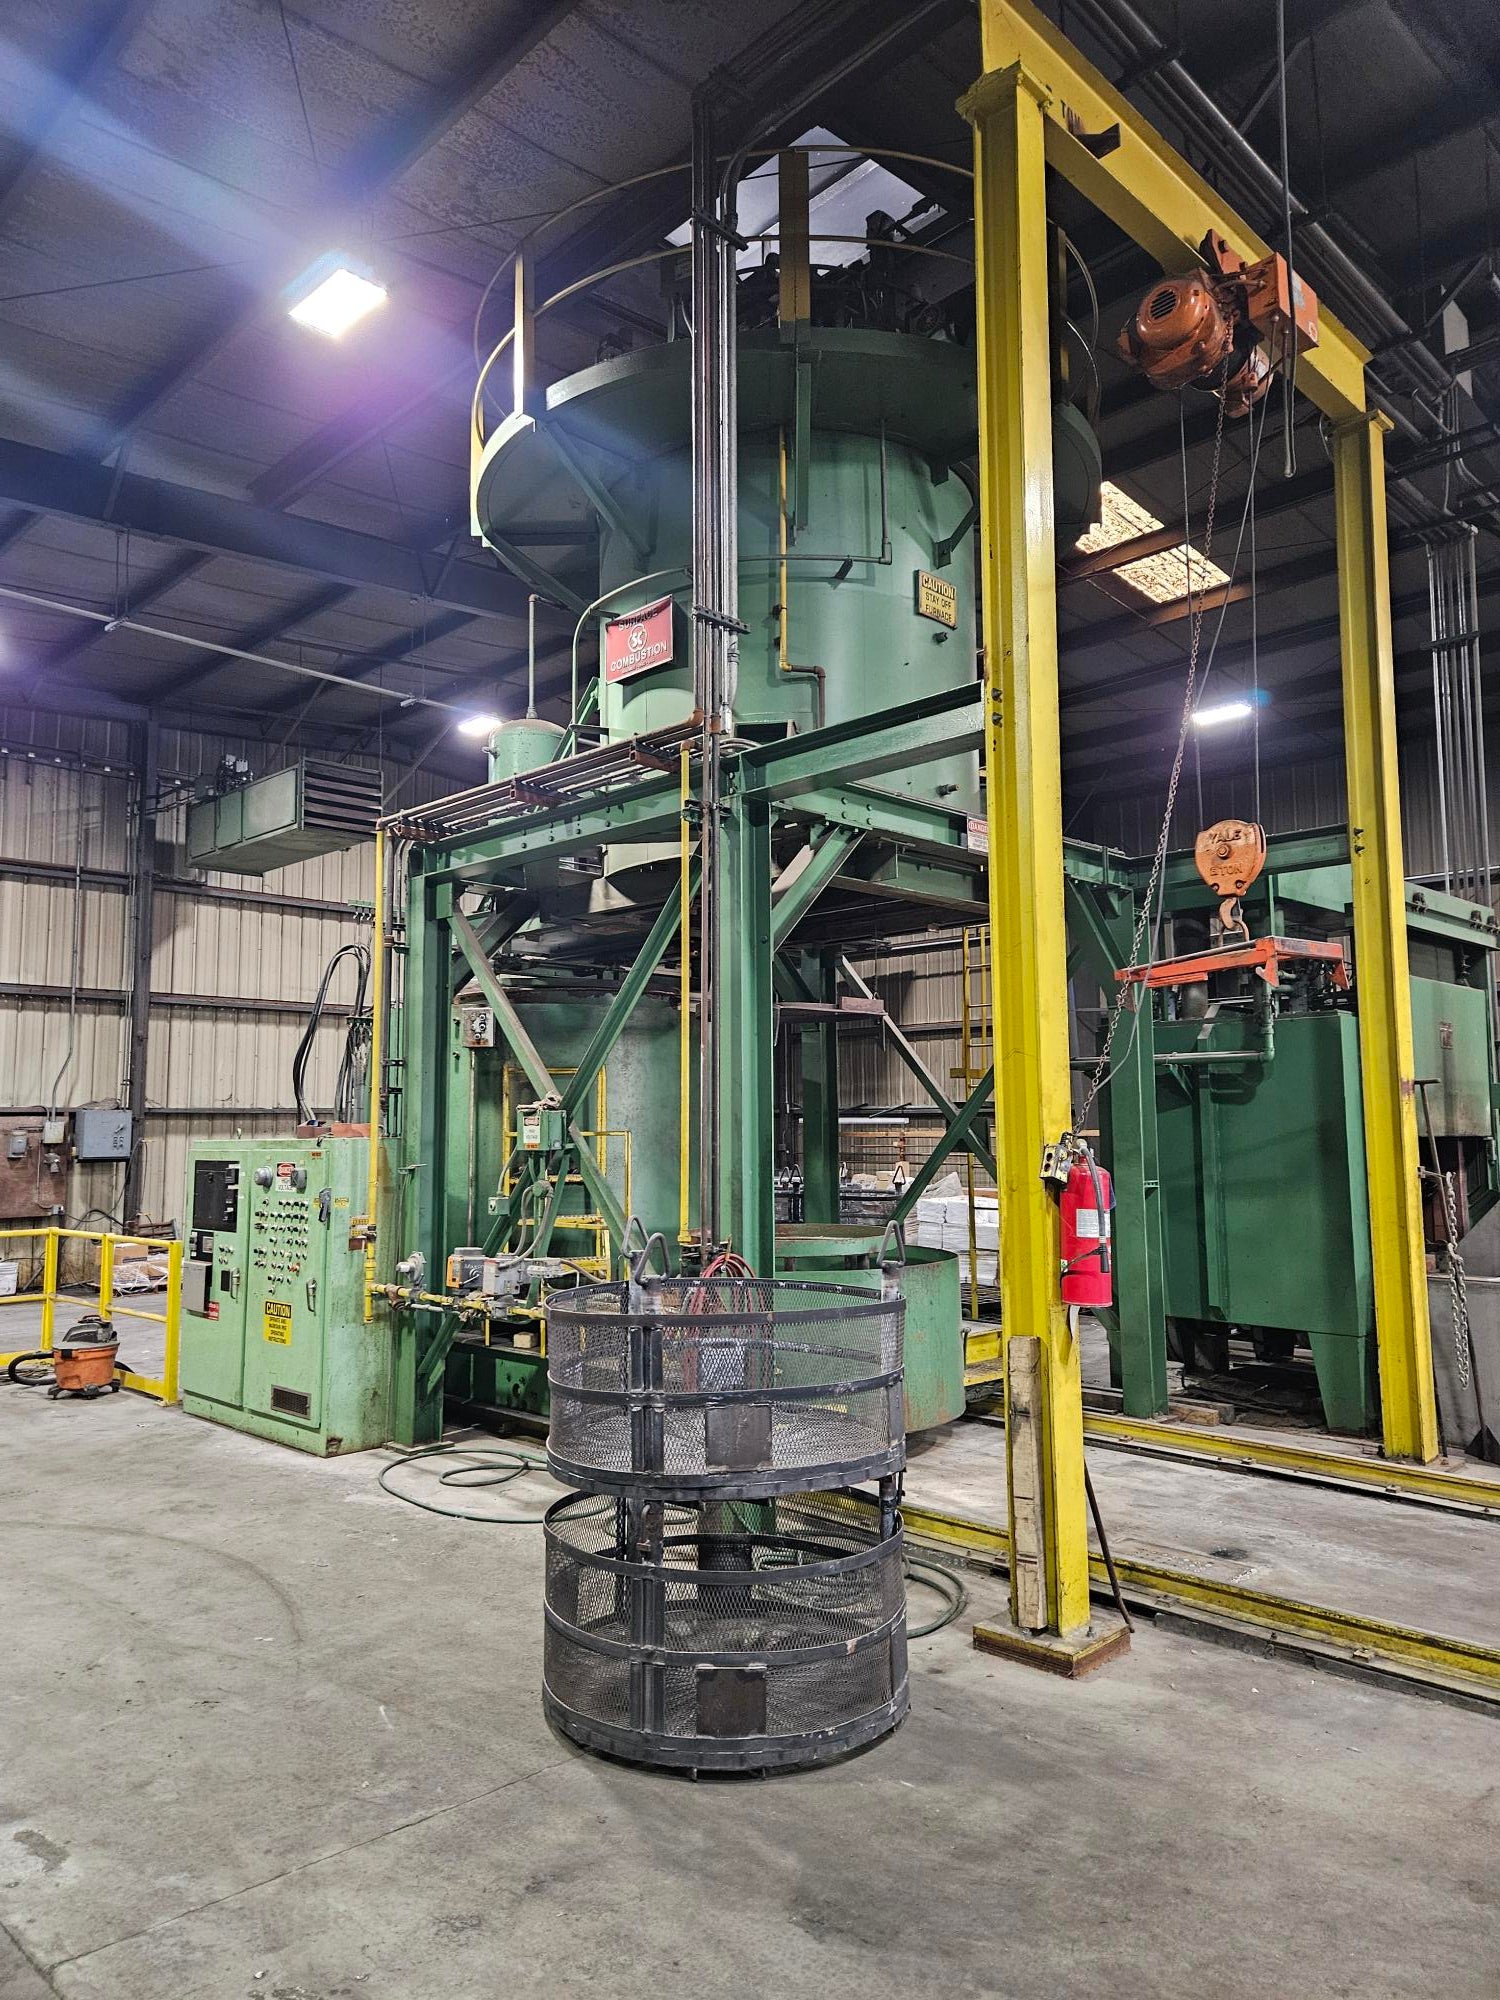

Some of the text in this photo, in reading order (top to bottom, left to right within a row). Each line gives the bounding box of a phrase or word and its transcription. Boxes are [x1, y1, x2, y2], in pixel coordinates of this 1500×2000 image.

[922, 575, 955, 599] CAUTION
[925, 592, 951, 610] STAY OFF
[925, 604, 952, 623] FURNACE
[610, 641, 668, 672] COMBUSTION
[1208, 828, 1242, 844] YALE
[266, 1302, 290, 1317] CAUTION
